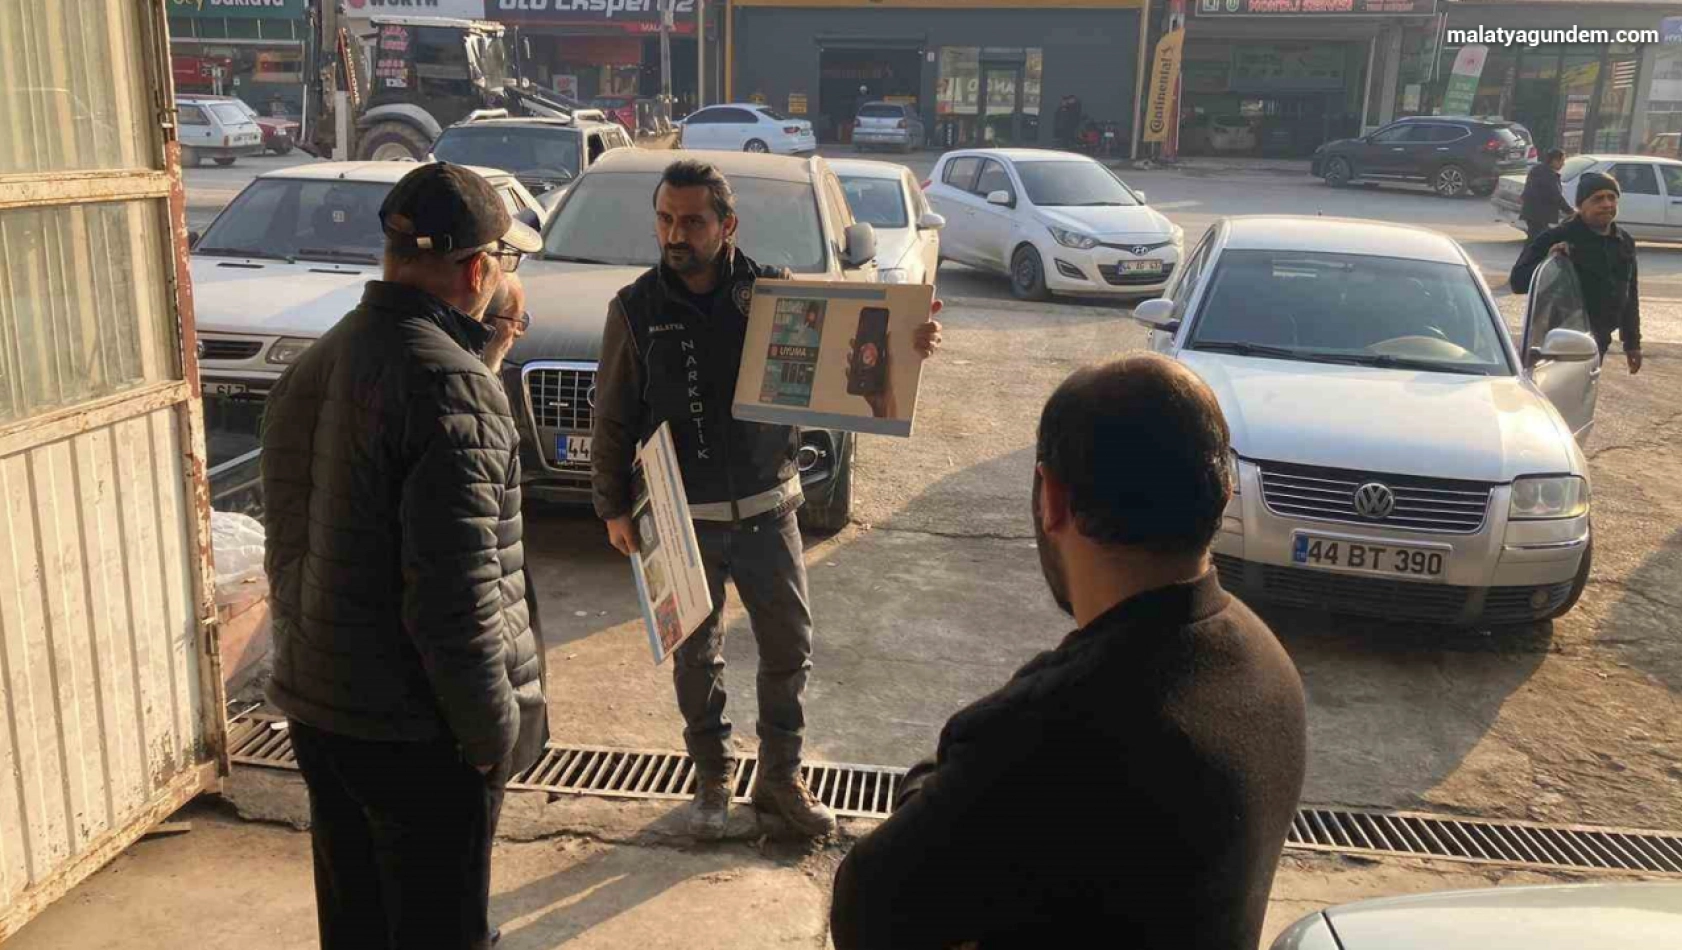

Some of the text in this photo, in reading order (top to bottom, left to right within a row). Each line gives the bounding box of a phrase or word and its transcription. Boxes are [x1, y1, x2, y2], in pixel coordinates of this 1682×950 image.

[1151, 57, 1173, 133] Continental
[569, 437, 590, 459] 44
[1308, 540, 1339, 564] 44
[1348, 544, 1387, 570] BT
[1394, 549, 1443, 575] 390
